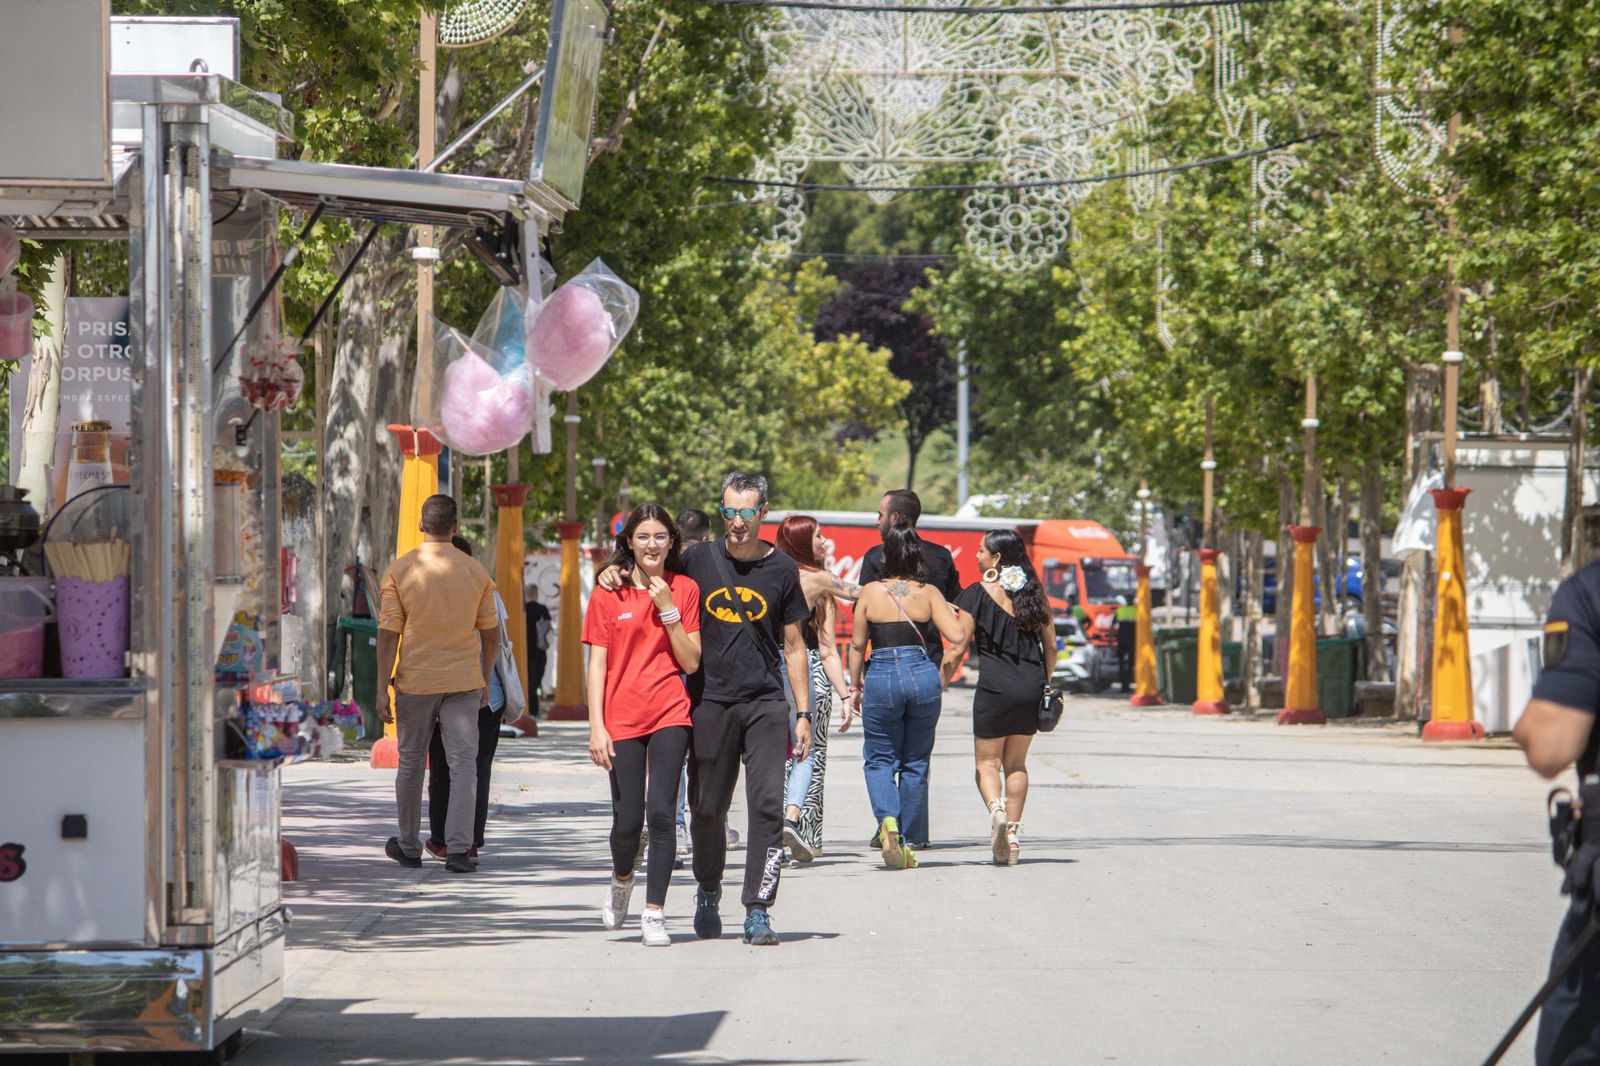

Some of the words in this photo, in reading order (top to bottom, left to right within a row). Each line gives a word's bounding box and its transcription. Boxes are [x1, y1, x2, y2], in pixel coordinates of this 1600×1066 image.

[79, 321, 131, 336] PRIS
[61, 366, 131, 381] ORPUS
[98, 394, 131, 402] ESPEC
